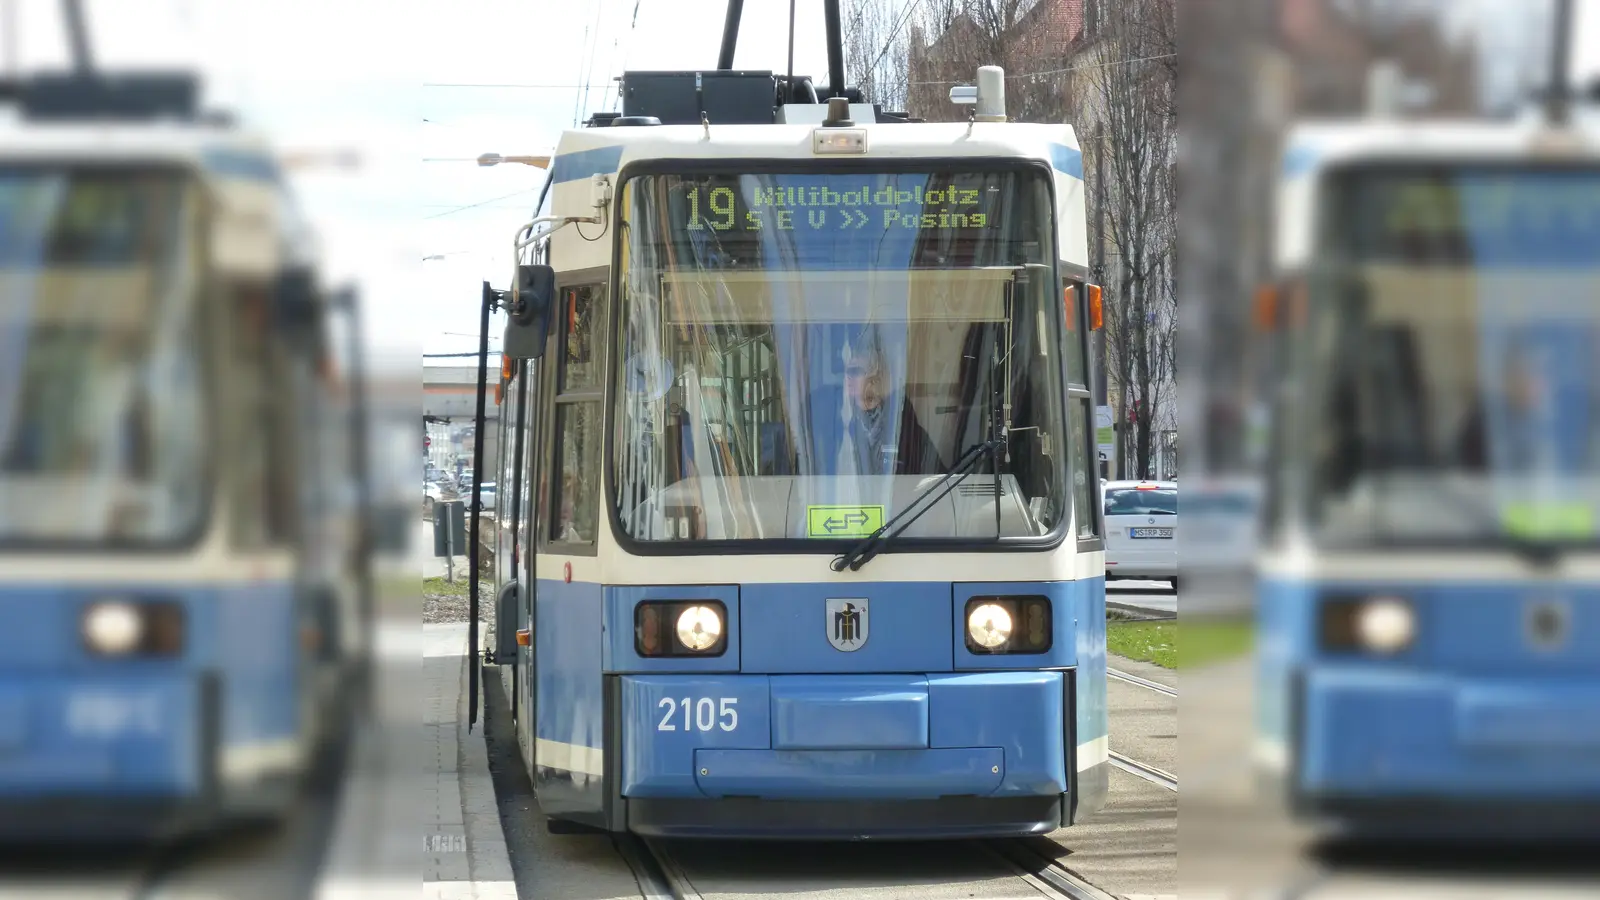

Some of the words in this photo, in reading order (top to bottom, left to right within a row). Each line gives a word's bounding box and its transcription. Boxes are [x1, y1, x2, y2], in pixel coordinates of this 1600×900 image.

[687, 187, 735, 230] 19
[754, 185, 979, 206] Willibaldplatz
[746, 210, 763, 230] S
[777, 210, 794, 230] E
[883, 209, 987, 228] Pasing
[657, 697, 738, 732] 2105
